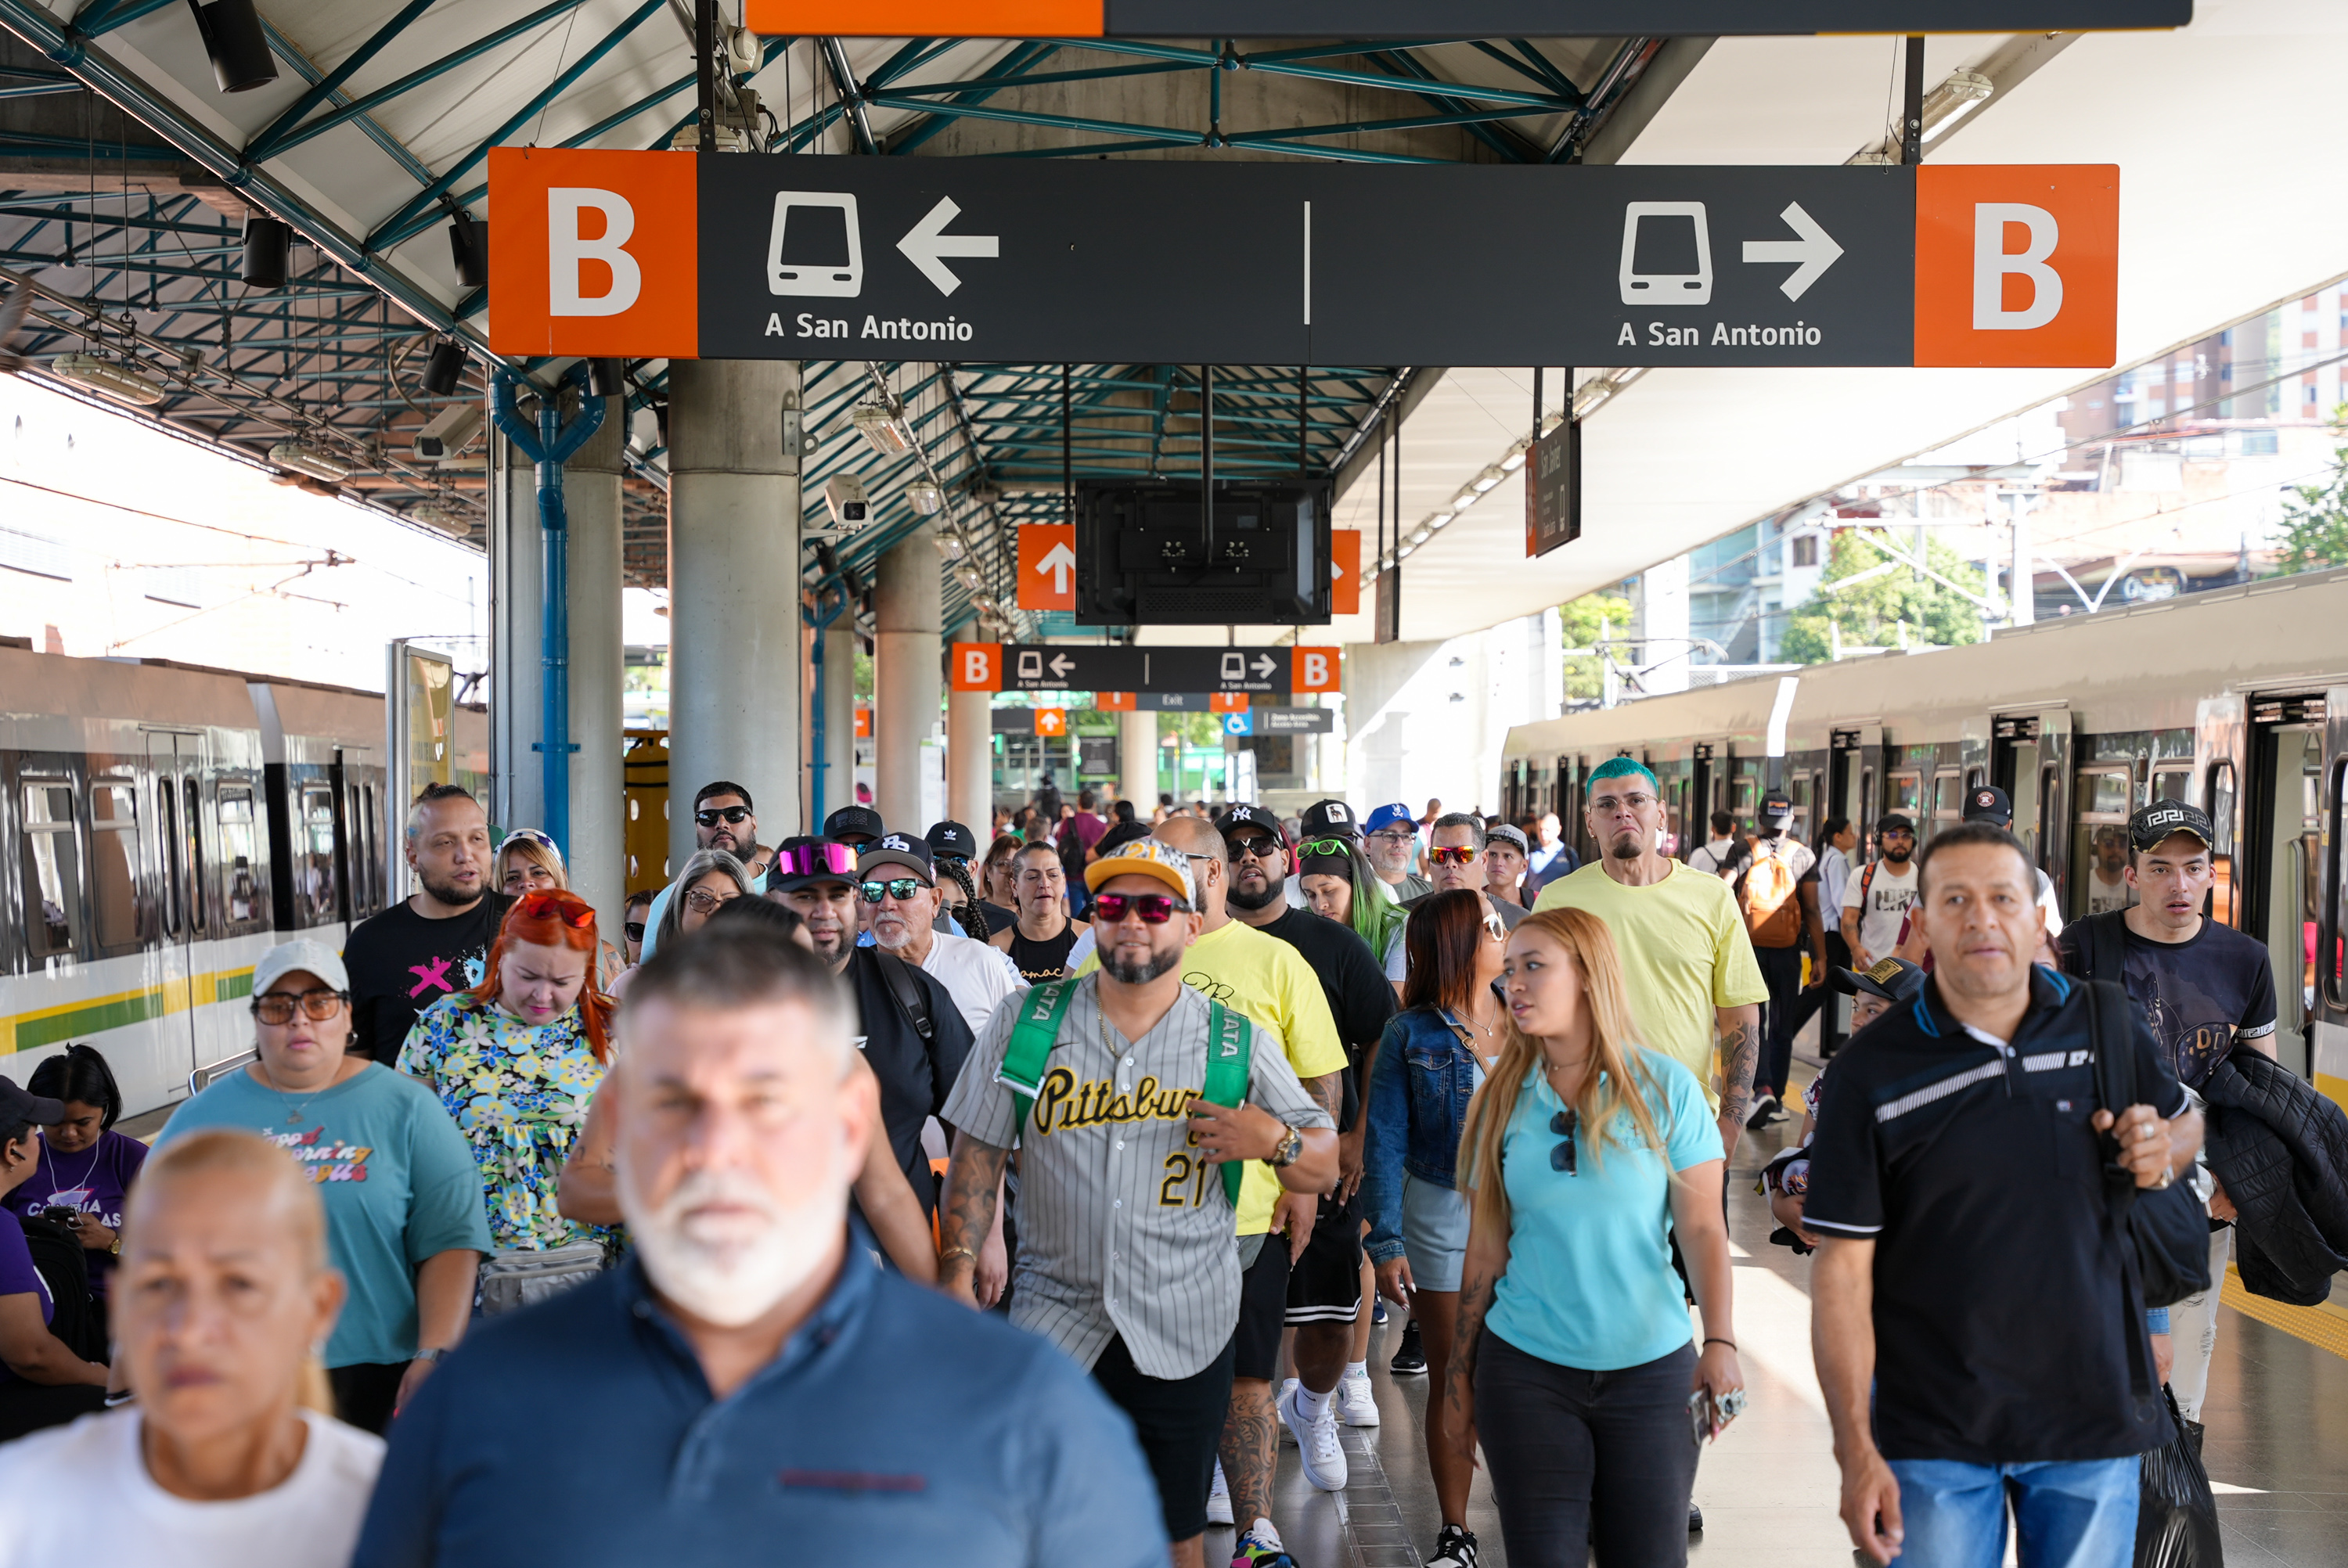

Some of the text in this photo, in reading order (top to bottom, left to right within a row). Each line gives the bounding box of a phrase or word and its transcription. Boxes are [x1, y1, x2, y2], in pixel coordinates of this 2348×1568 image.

[549, 188, 641, 316] B
[1973, 203, 2064, 329] B
[765, 313, 972, 341] A San Antonio
[1618, 321, 1820, 346] A San Antonio
[965, 651, 989, 683] B
[1305, 653, 1329, 686] B
[1017, 680, 1069, 689] A San Antonio
[1220, 682, 1273, 690] A San Antonio
[1162, 693, 1183, 707] Exit
[1125, 842, 1157, 861] 21
[1159, 1152, 1208, 1207] 21
